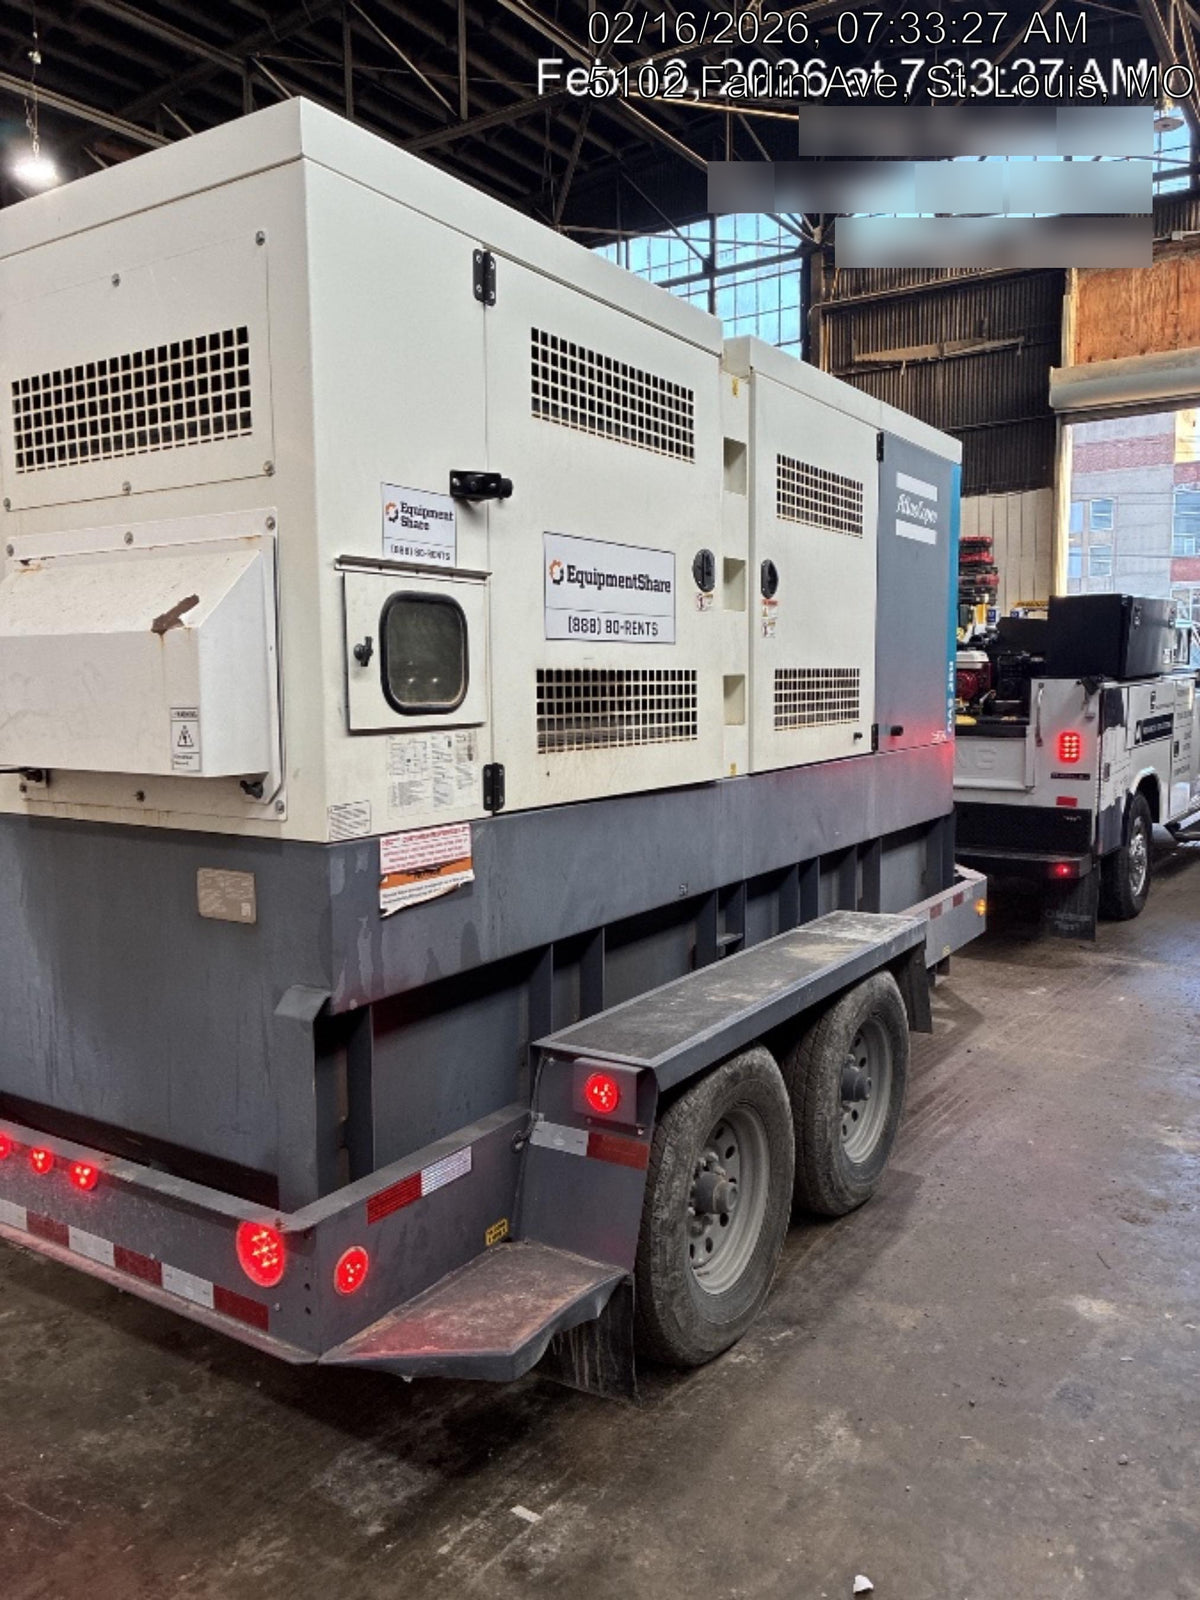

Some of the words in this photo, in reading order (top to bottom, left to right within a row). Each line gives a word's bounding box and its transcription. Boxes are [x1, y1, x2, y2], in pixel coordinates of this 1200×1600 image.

[400, 501, 454, 521] Equipment
[400, 516, 430, 531] Share
[566, 564, 671, 592] EquipmentShare
[568, 615, 602, 635] (888)
